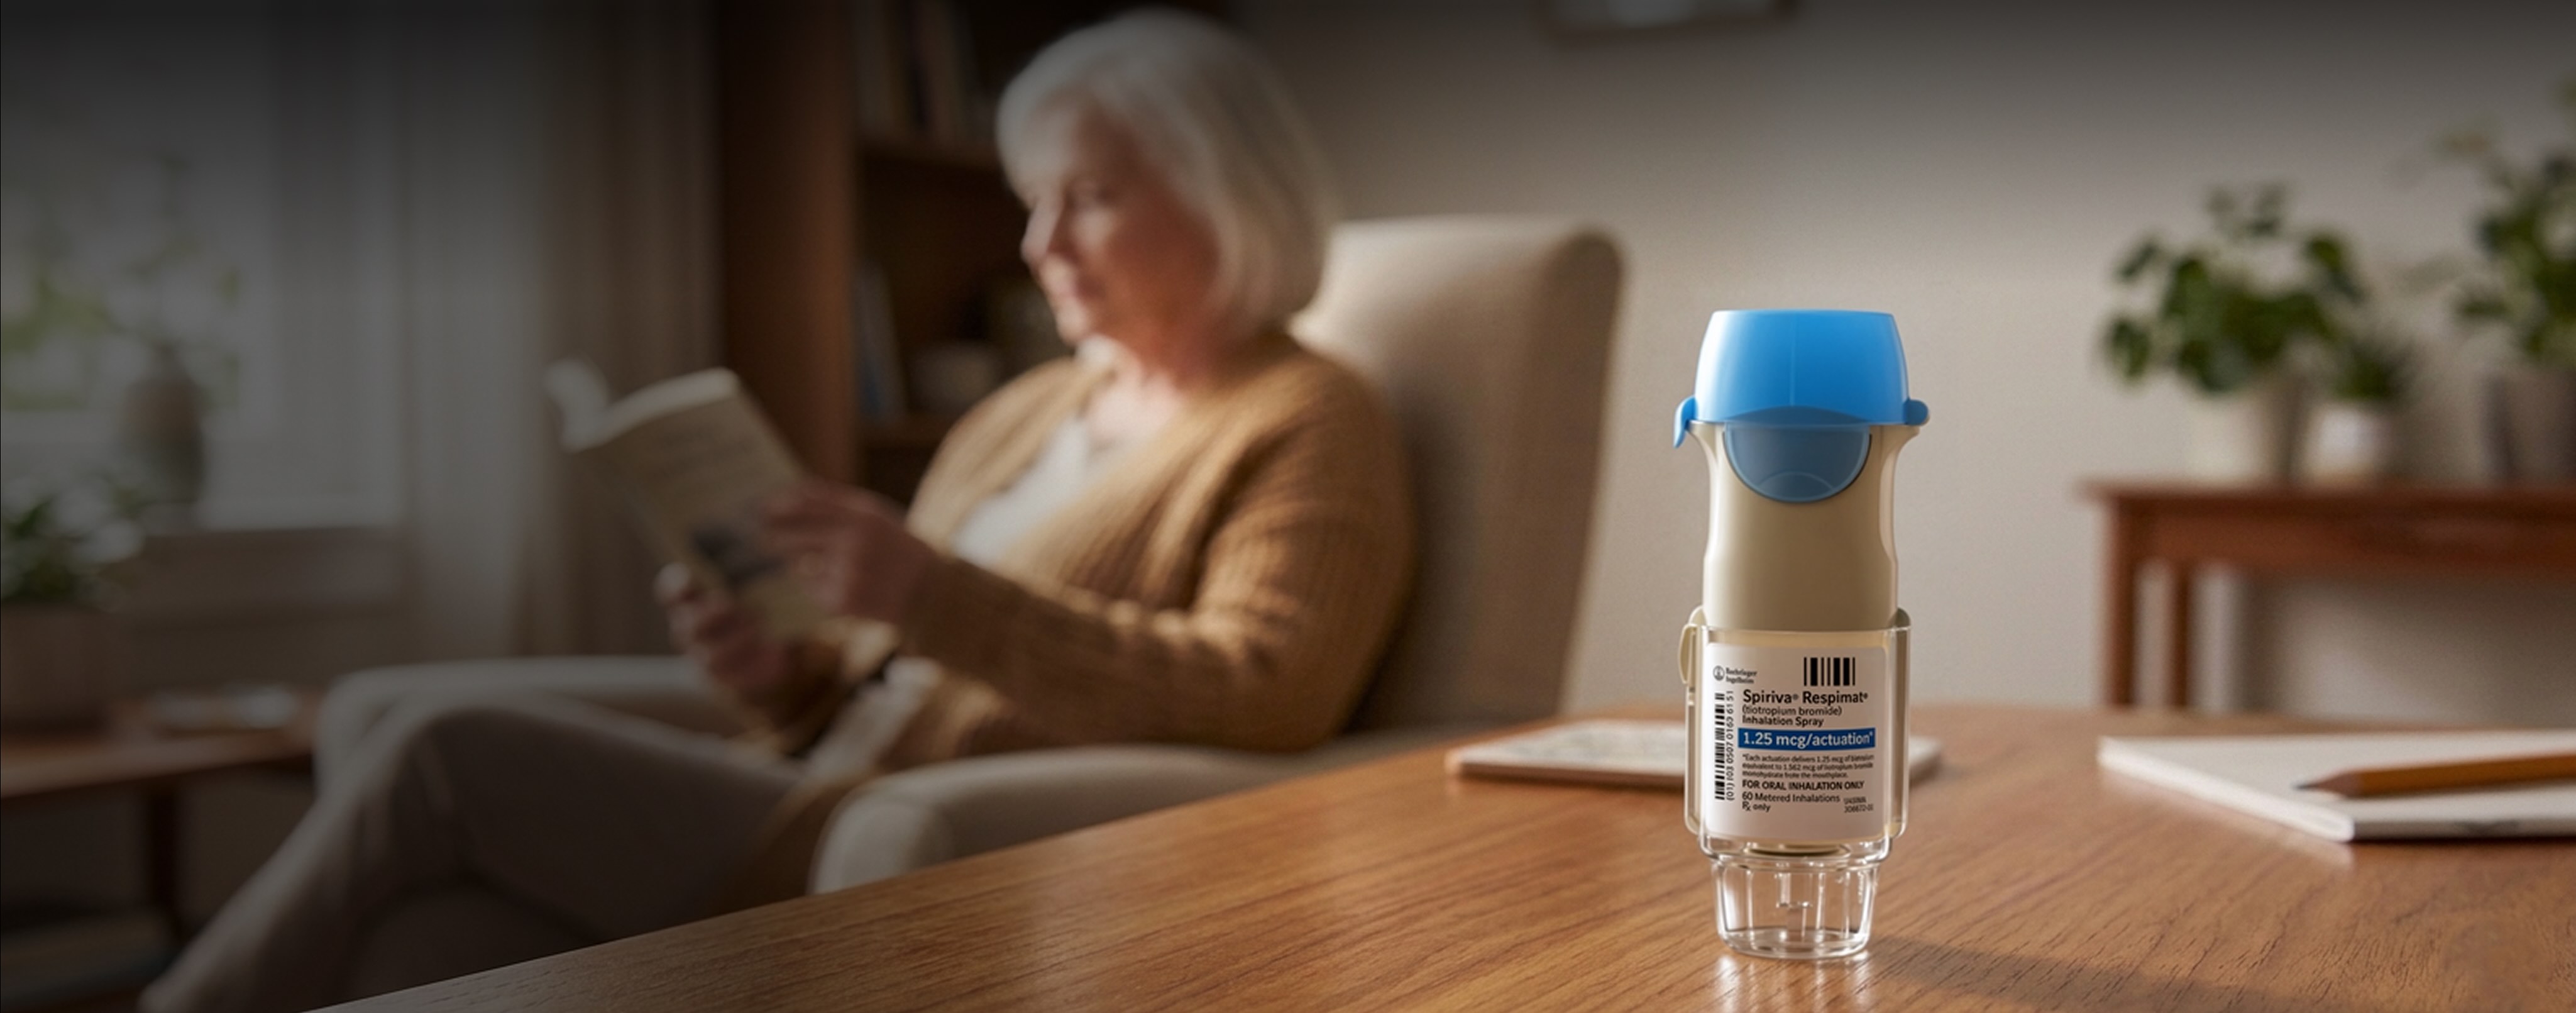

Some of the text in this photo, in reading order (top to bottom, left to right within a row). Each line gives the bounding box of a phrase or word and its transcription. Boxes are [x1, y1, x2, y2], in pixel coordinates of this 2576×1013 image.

[1798, 706, 1842, 716] bromide)
[1742, 715, 1824, 728] Inhalation Spray
[1744, 732, 1773, 745] 1.25
[1742, 780, 1864, 790] FOR ORAL INHALATION ONLY
[1742, 792, 1753, 800] 60
[1754, 793, 1790, 802] Metered
[1793, 794, 1840, 802] Inhalations
[1753, 804, 1770, 812] only
